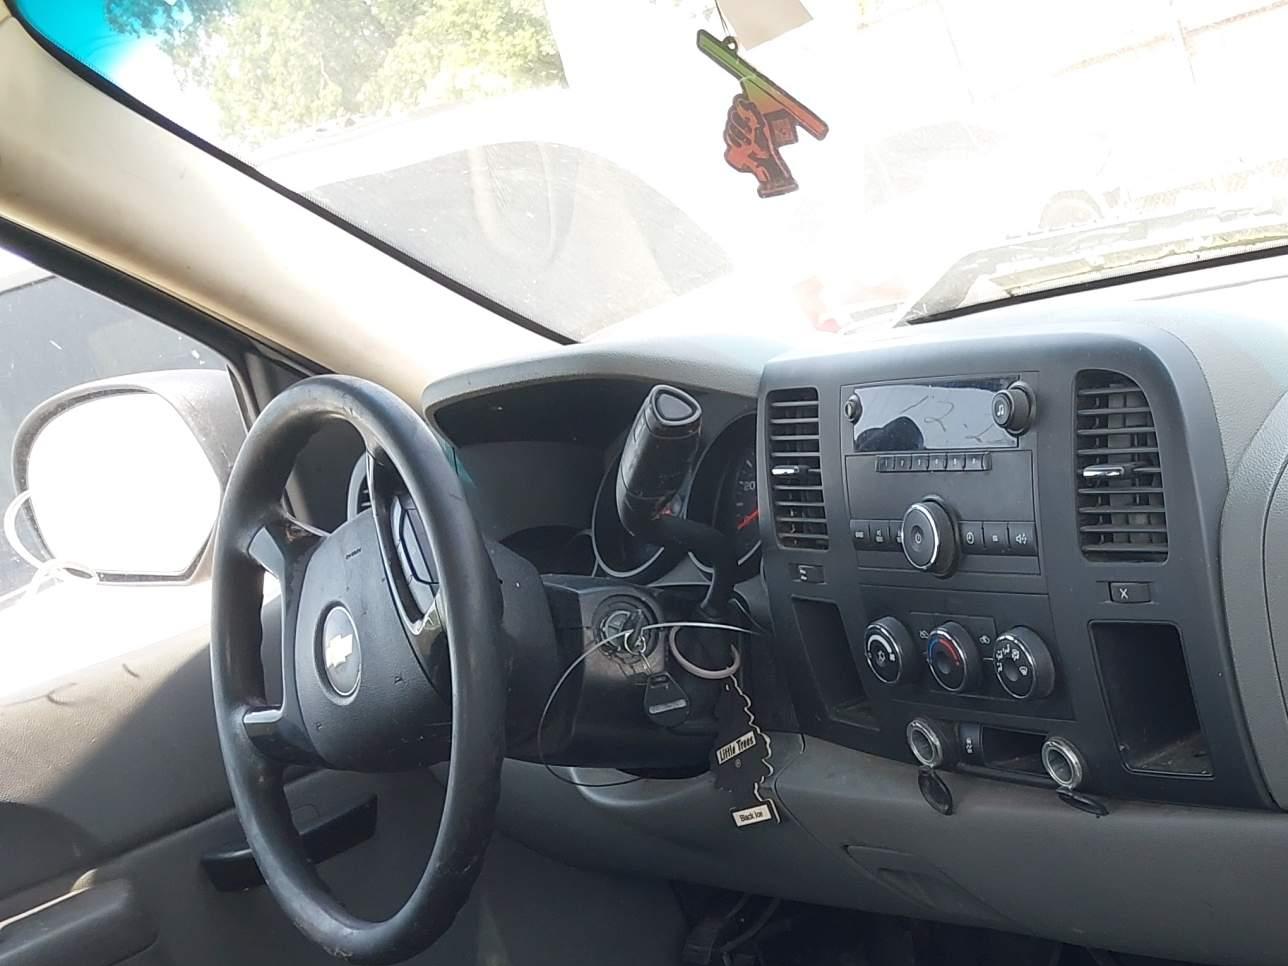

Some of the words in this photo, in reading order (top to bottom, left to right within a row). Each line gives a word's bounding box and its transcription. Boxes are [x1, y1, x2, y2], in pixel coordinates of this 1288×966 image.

[719, 744, 736, 761] Little
[736, 737, 754, 751] Trees
[739, 812, 755, 822] Black
